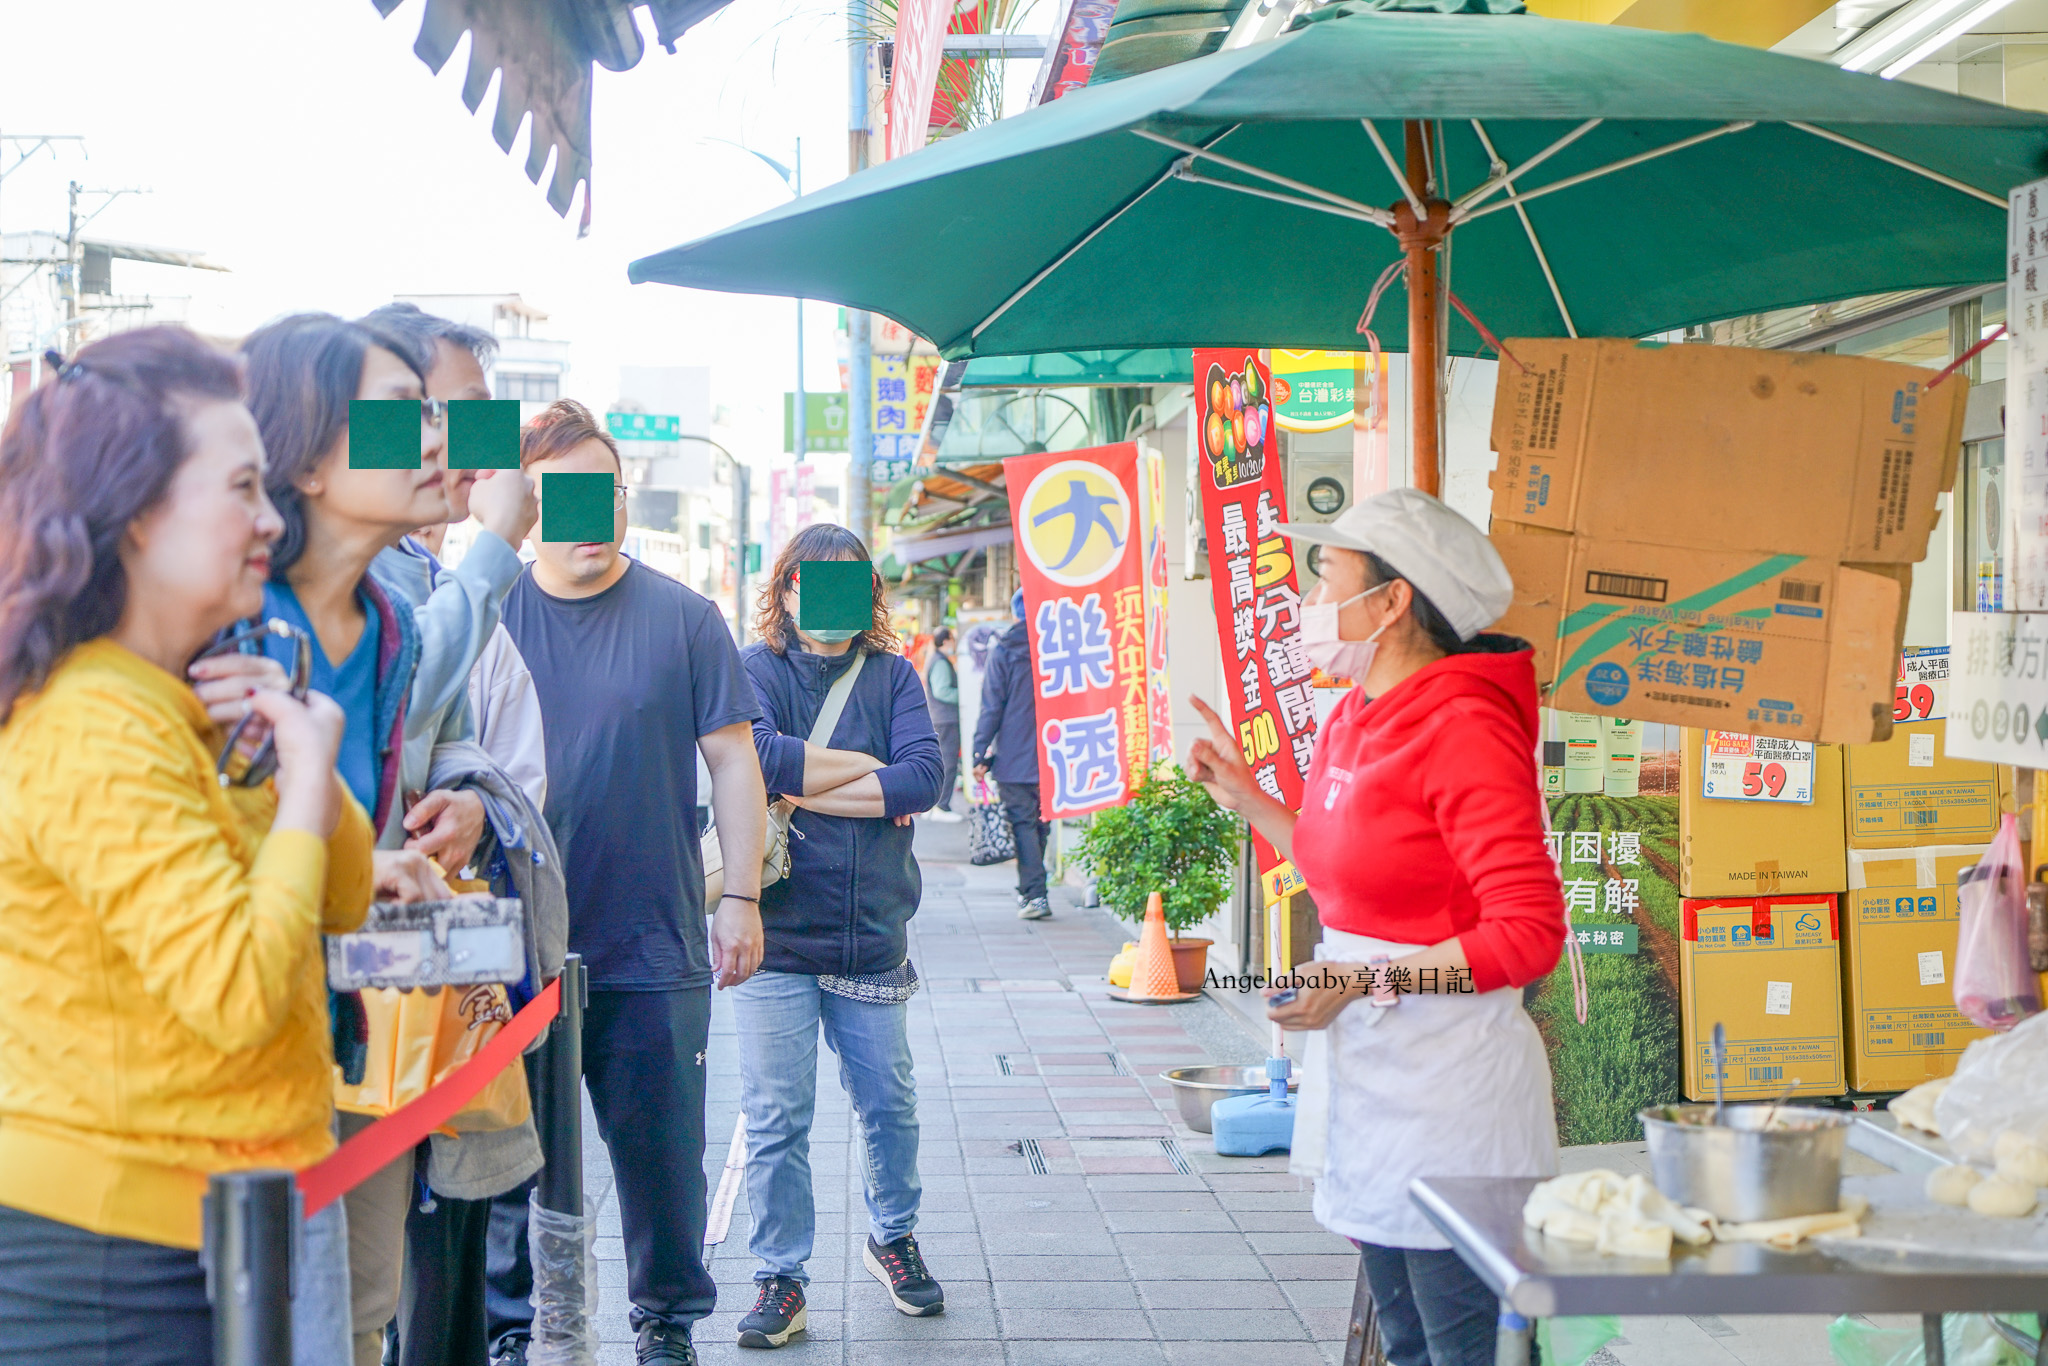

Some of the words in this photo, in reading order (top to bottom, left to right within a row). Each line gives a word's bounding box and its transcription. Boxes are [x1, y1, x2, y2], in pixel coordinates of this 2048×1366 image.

[1632, 604, 1674, 618] Water
[1679, 608, 1702, 622] Ion
[1708, 613, 1765, 630] Alkaline
[1033, 481, 1124, 812] 大樂透
[1628, 627, 1763, 664] 鹼性離子水
[1967, 628, 2048, 680] 排隊方
[1907, 658, 1949, 671] 成人平面
[1893, 684, 1934, 721] 59
[1756, 739, 1800, 751] 宏瑋成人
[1754, 750, 1811, 761] 平面醫療口罩
[1707, 781, 1714, 794] $
[1742, 762, 1787, 798] 59
[1797, 787, 1807, 798] 元
[1728, 871, 1756, 881] MADE
[1759, 871, 1769, 879] IN
[1770, 870, 1808, 879] TAIWAN
[1563, 877, 1639, 914] 有解
